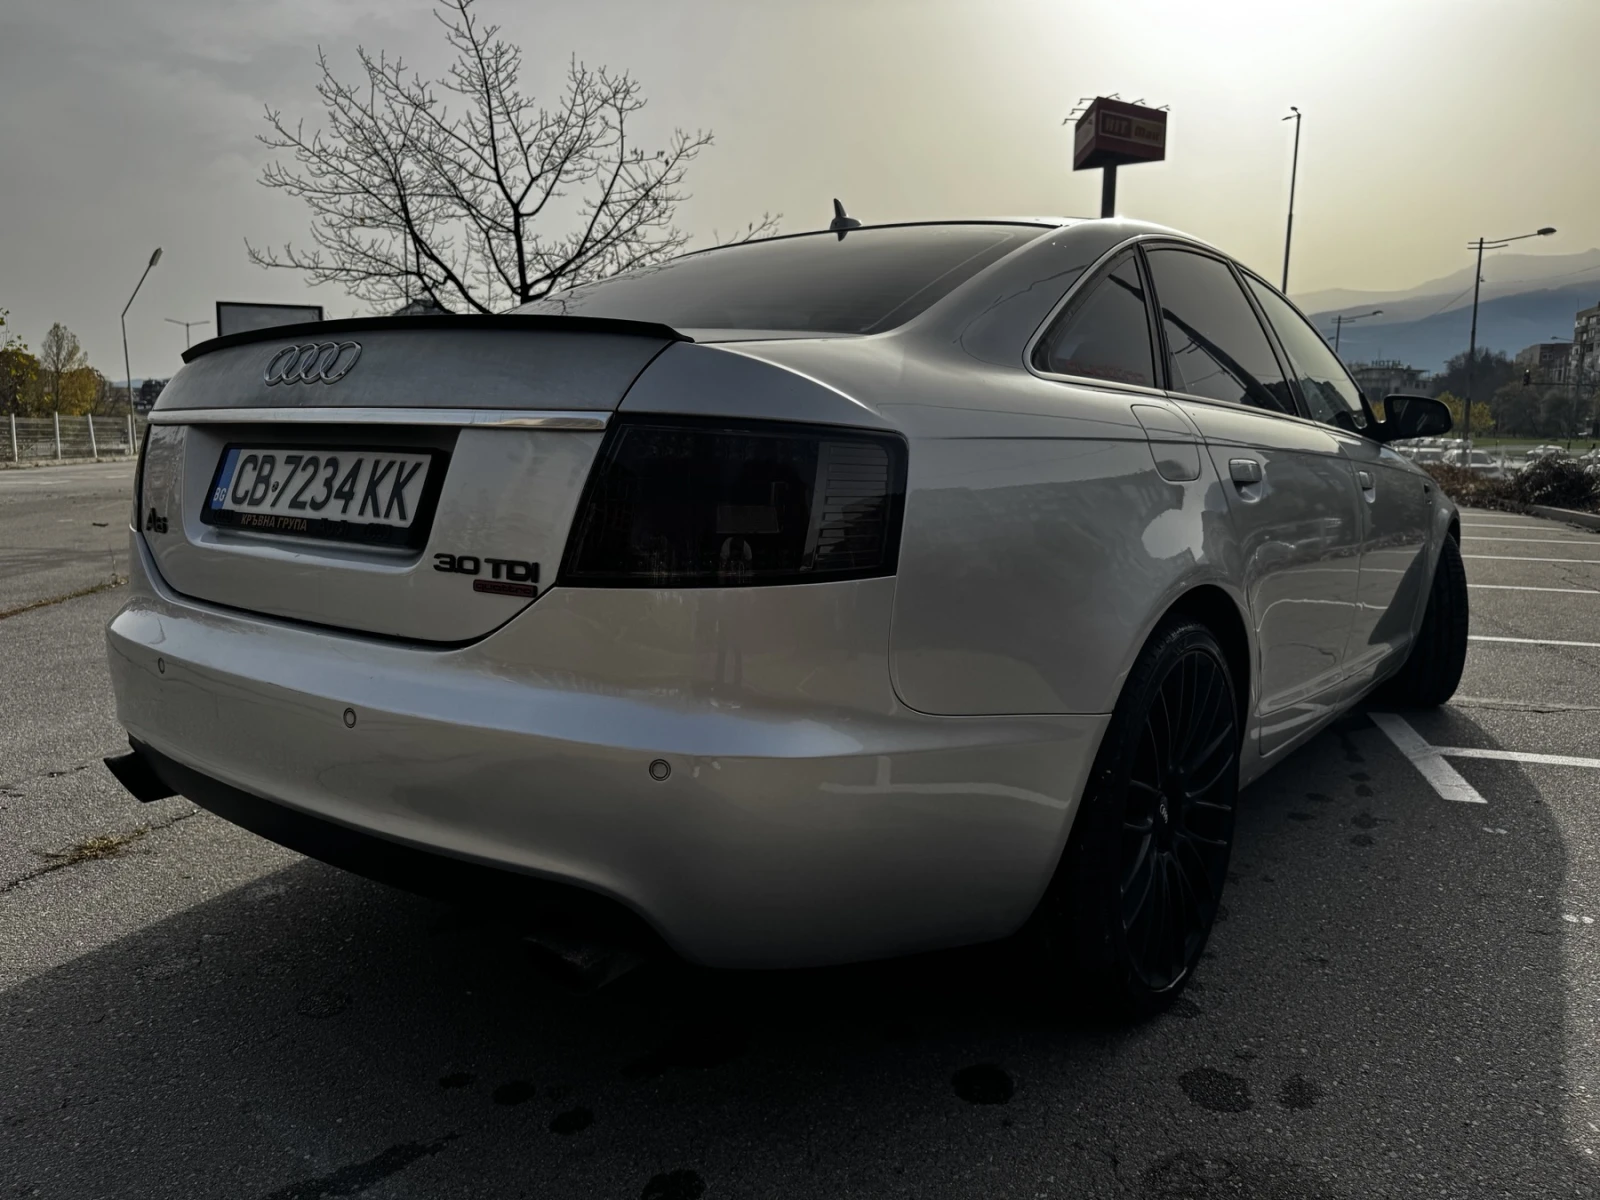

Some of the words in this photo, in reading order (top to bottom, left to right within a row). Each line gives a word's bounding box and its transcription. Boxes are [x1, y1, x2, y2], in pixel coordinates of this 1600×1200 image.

[213, 486, 227, 501] BG
[240, 513, 276, 528] КРЪВНА
[276, 518, 307, 532] ГРУПА
[484, 558, 540, 583] TDI
[475, 582, 532, 595] quattro
